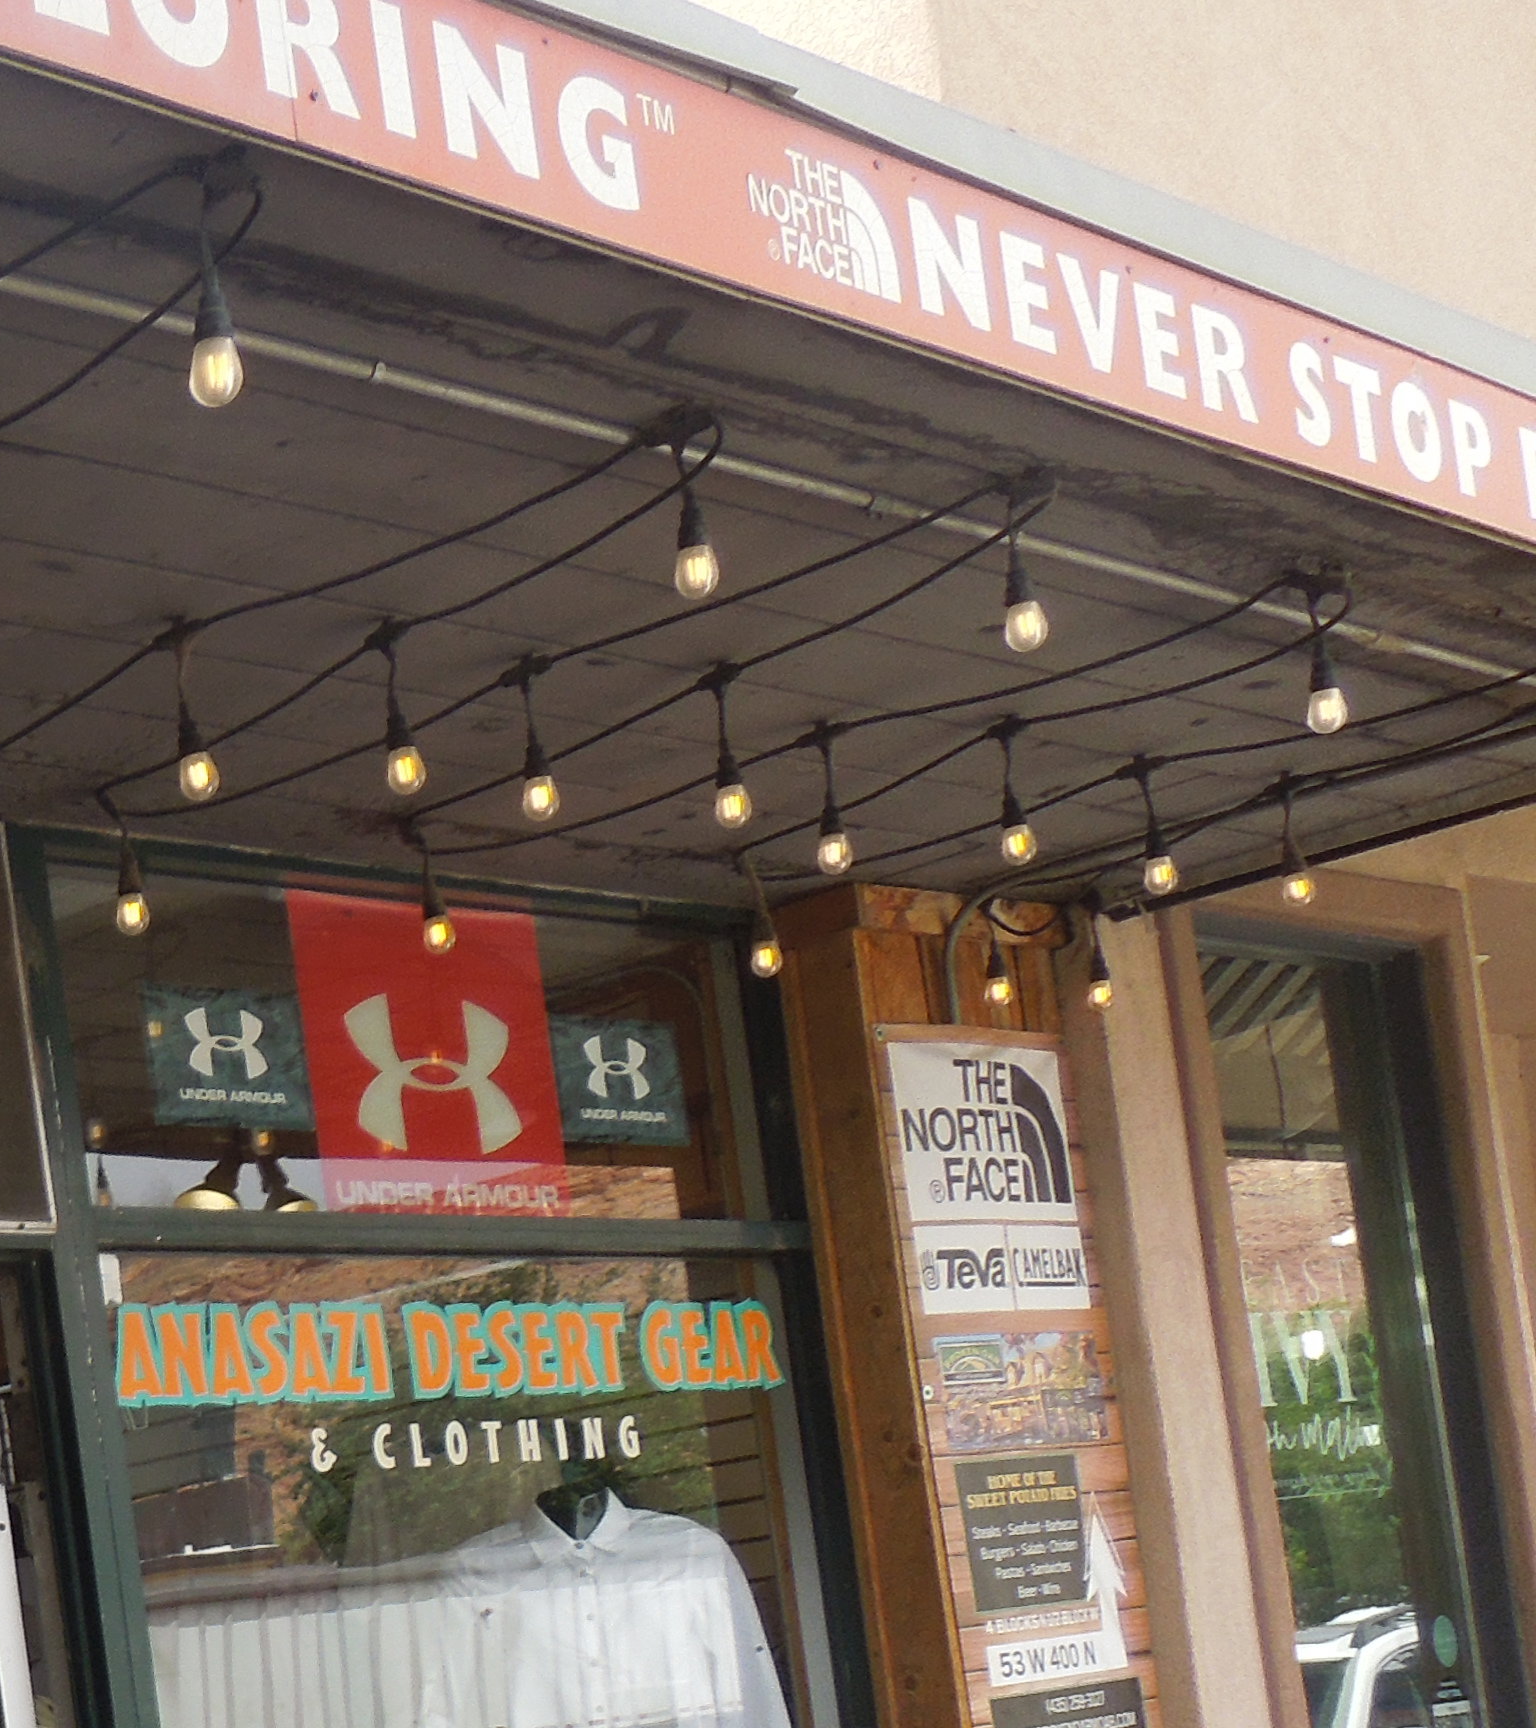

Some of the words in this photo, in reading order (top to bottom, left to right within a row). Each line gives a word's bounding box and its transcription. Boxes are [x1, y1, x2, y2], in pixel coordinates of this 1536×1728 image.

[35, 0, 640, 210] ORING
[784, 149, 843, 204] THE
[747, 173, 848, 244] NORTH
[781, 226, 854, 287] FACE
[908, 196, 1260, 424] NEVER
[1289, 341, 1492, 498] STOP
[179, 1087, 227, 1101] UNDER
[230, 1089, 287, 1104] ARMOUR
[952, 1058, 1009, 1105] THE
[579, 1107, 617, 1120] UNDER
[618, 1109, 668, 1123] ARMOUR
[902, 1107, 1019, 1152] NORTH
[335, 1179, 434, 1207] UNDER
[443, 1180, 561, 1209] ARMOUR
[943, 1157, 1022, 1202] FACE
[936, 1248, 1008, 1289] Teva
[1012, 1247, 1087, 1288] CAMELBAK
[116, 1301, 396, 1407] ANASAZI
[402, 1301, 631, 1399] DESERT
[639, 1298, 786, 1392] GEAR
[310, 1426, 339, 1473] &
[373, 1415, 642, 1470] CLOTHING
[1000, 1651, 1026, 1678] 53
[1028, 1648, 1045, 1674] W
[1051, 1643, 1080, 1670] 400
[1083, 1640, 1096, 1665] N
